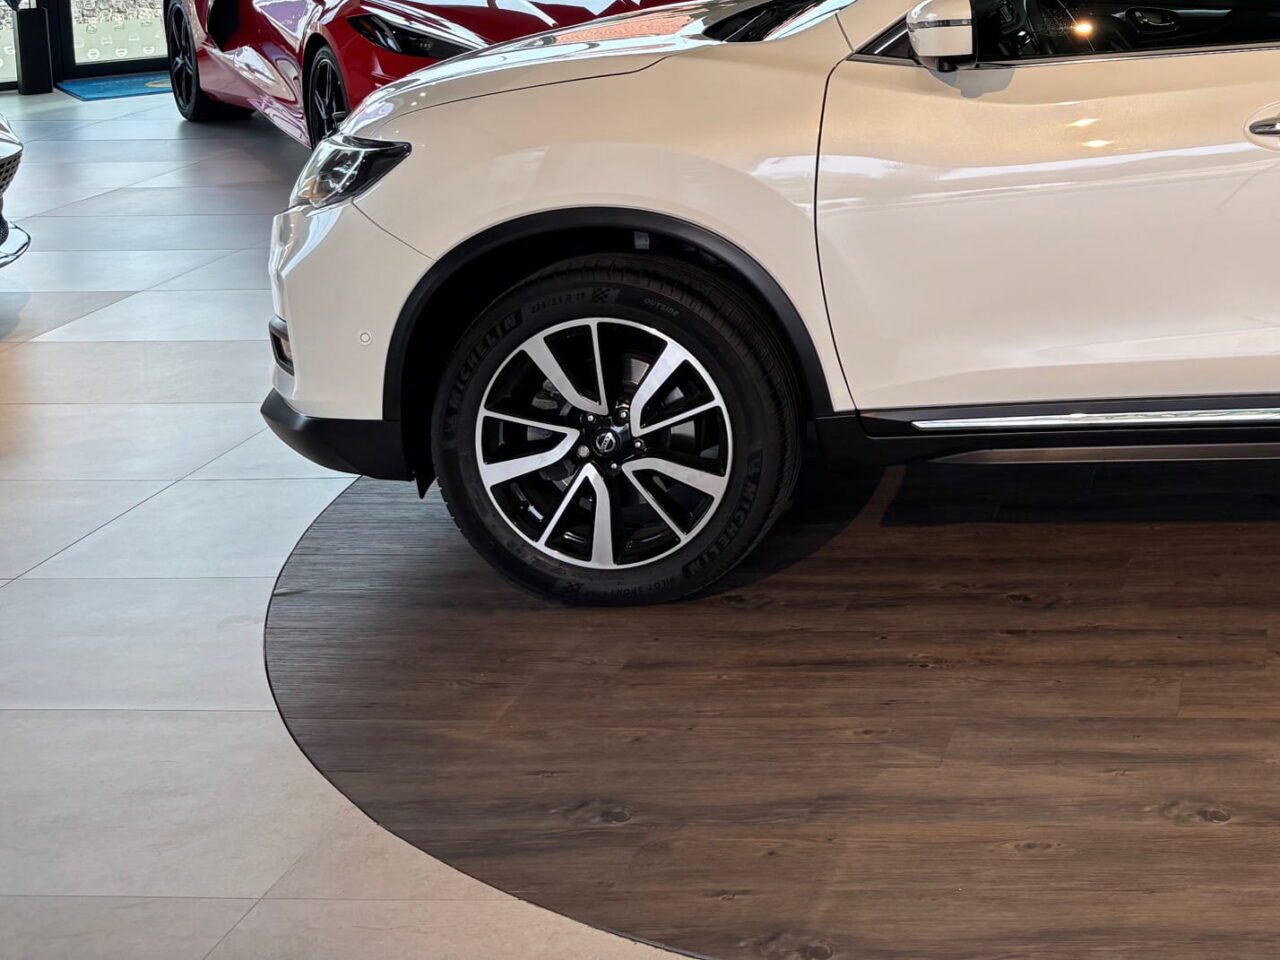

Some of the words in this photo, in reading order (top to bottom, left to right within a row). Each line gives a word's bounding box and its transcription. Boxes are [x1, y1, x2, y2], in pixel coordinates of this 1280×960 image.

[643, 297, 682, 318] OUTSIDE
[449, 312, 517, 410] MICHELIN
[687, 480, 759, 576] MICHELIN
